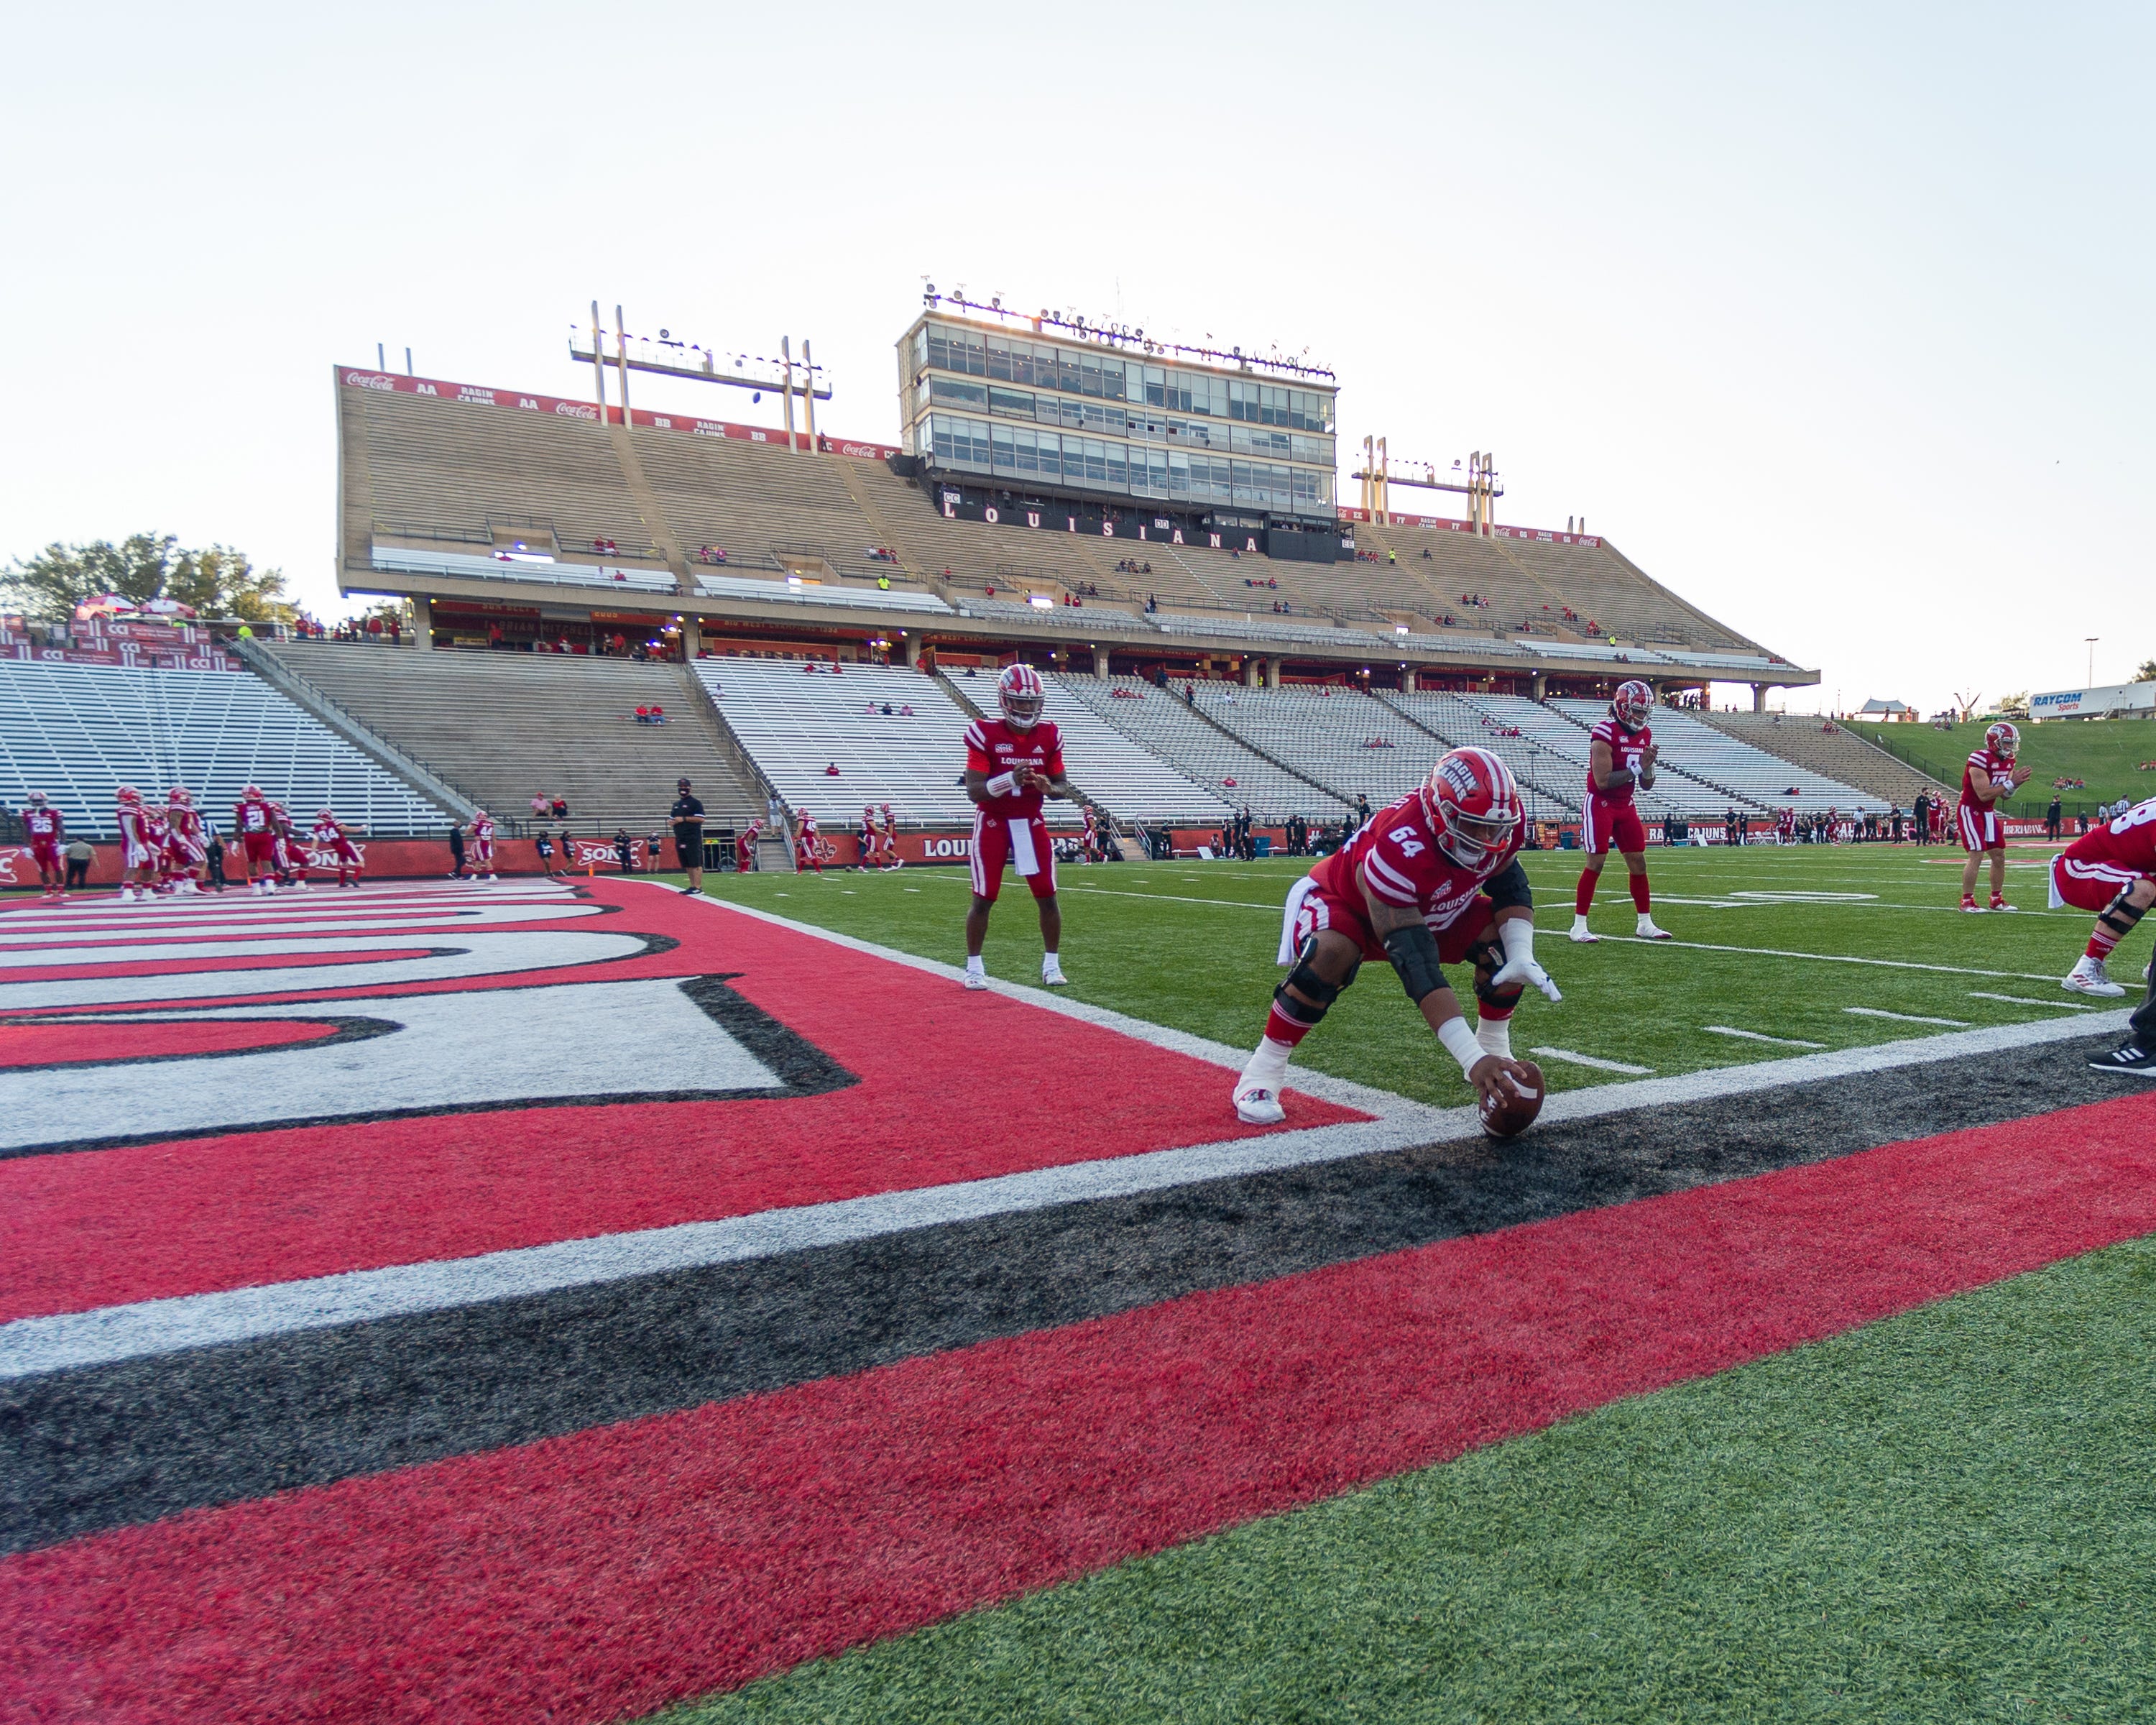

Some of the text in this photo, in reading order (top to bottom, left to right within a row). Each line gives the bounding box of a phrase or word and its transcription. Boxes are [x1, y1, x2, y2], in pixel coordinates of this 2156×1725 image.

[347, 372, 395, 390] Coca-Cola
[417, 384, 437, 395] AA
[520, 398, 538, 410] AA
[556, 402, 597, 420] Coca-Cola
[655, 418, 671, 428] BB
[752, 431, 766, 441] BB
[843, 443, 876, 458] Coca-Cola
[945, 493, 959, 502] CC
[944, 502, 1257, 552] LOUISIANA
[1156, 520, 1169, 529] DD
[2033, 692, 2082, 707] RAYCOM
[2058, 702, 2079, 712] Sports
[1388, 826, 1425, 858] 64
[582, 847, 640, 861] SONC
